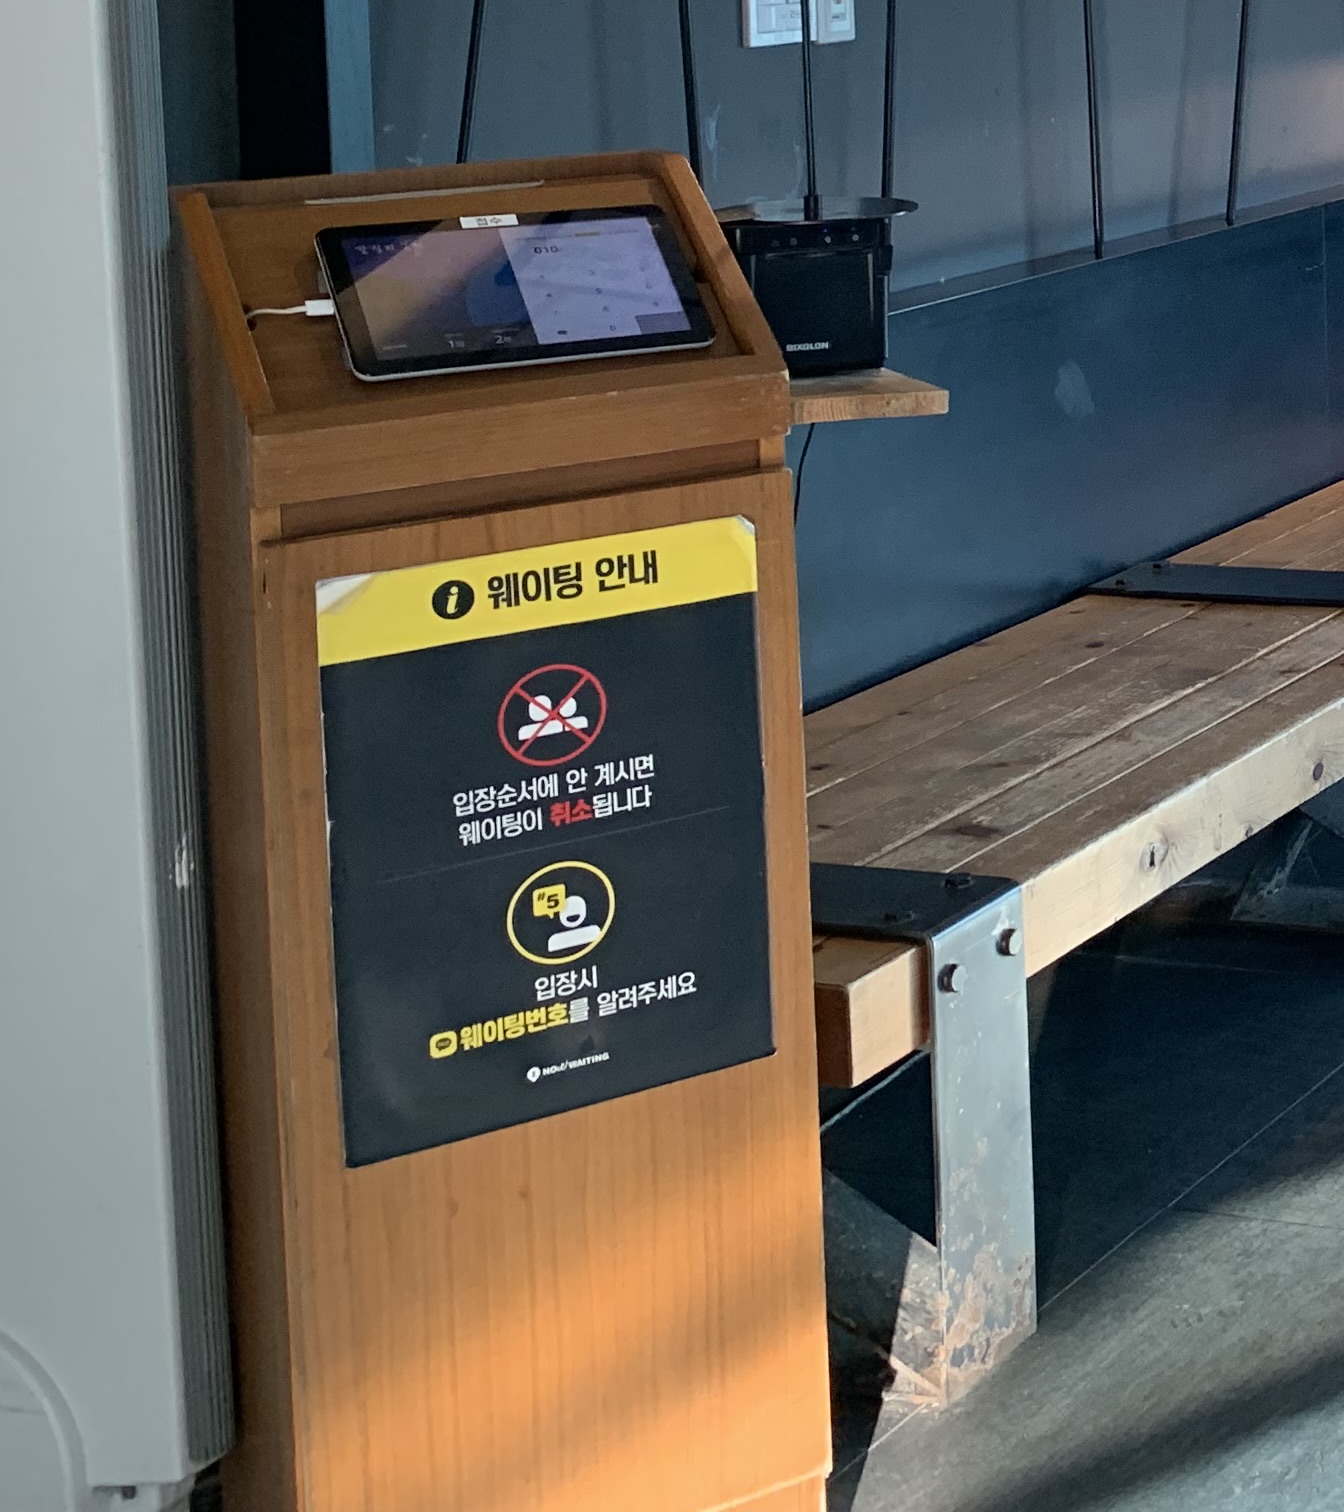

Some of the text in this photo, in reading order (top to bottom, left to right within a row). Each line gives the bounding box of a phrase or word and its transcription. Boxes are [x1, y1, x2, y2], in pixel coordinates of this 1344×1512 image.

[786, 341, 829, 352] BIXOLON
[488, 550, 658, 610] 웨이팅 안내
[453, 754, 656, 817] 입장순서에 안 계시면
[459, 786, 652, 847] 웨이팅이 취소됩니다
[460, 972, 698, 1053] 웨이팅번호를 알려주세요
[535, 966, 598, 1001] 입장시
